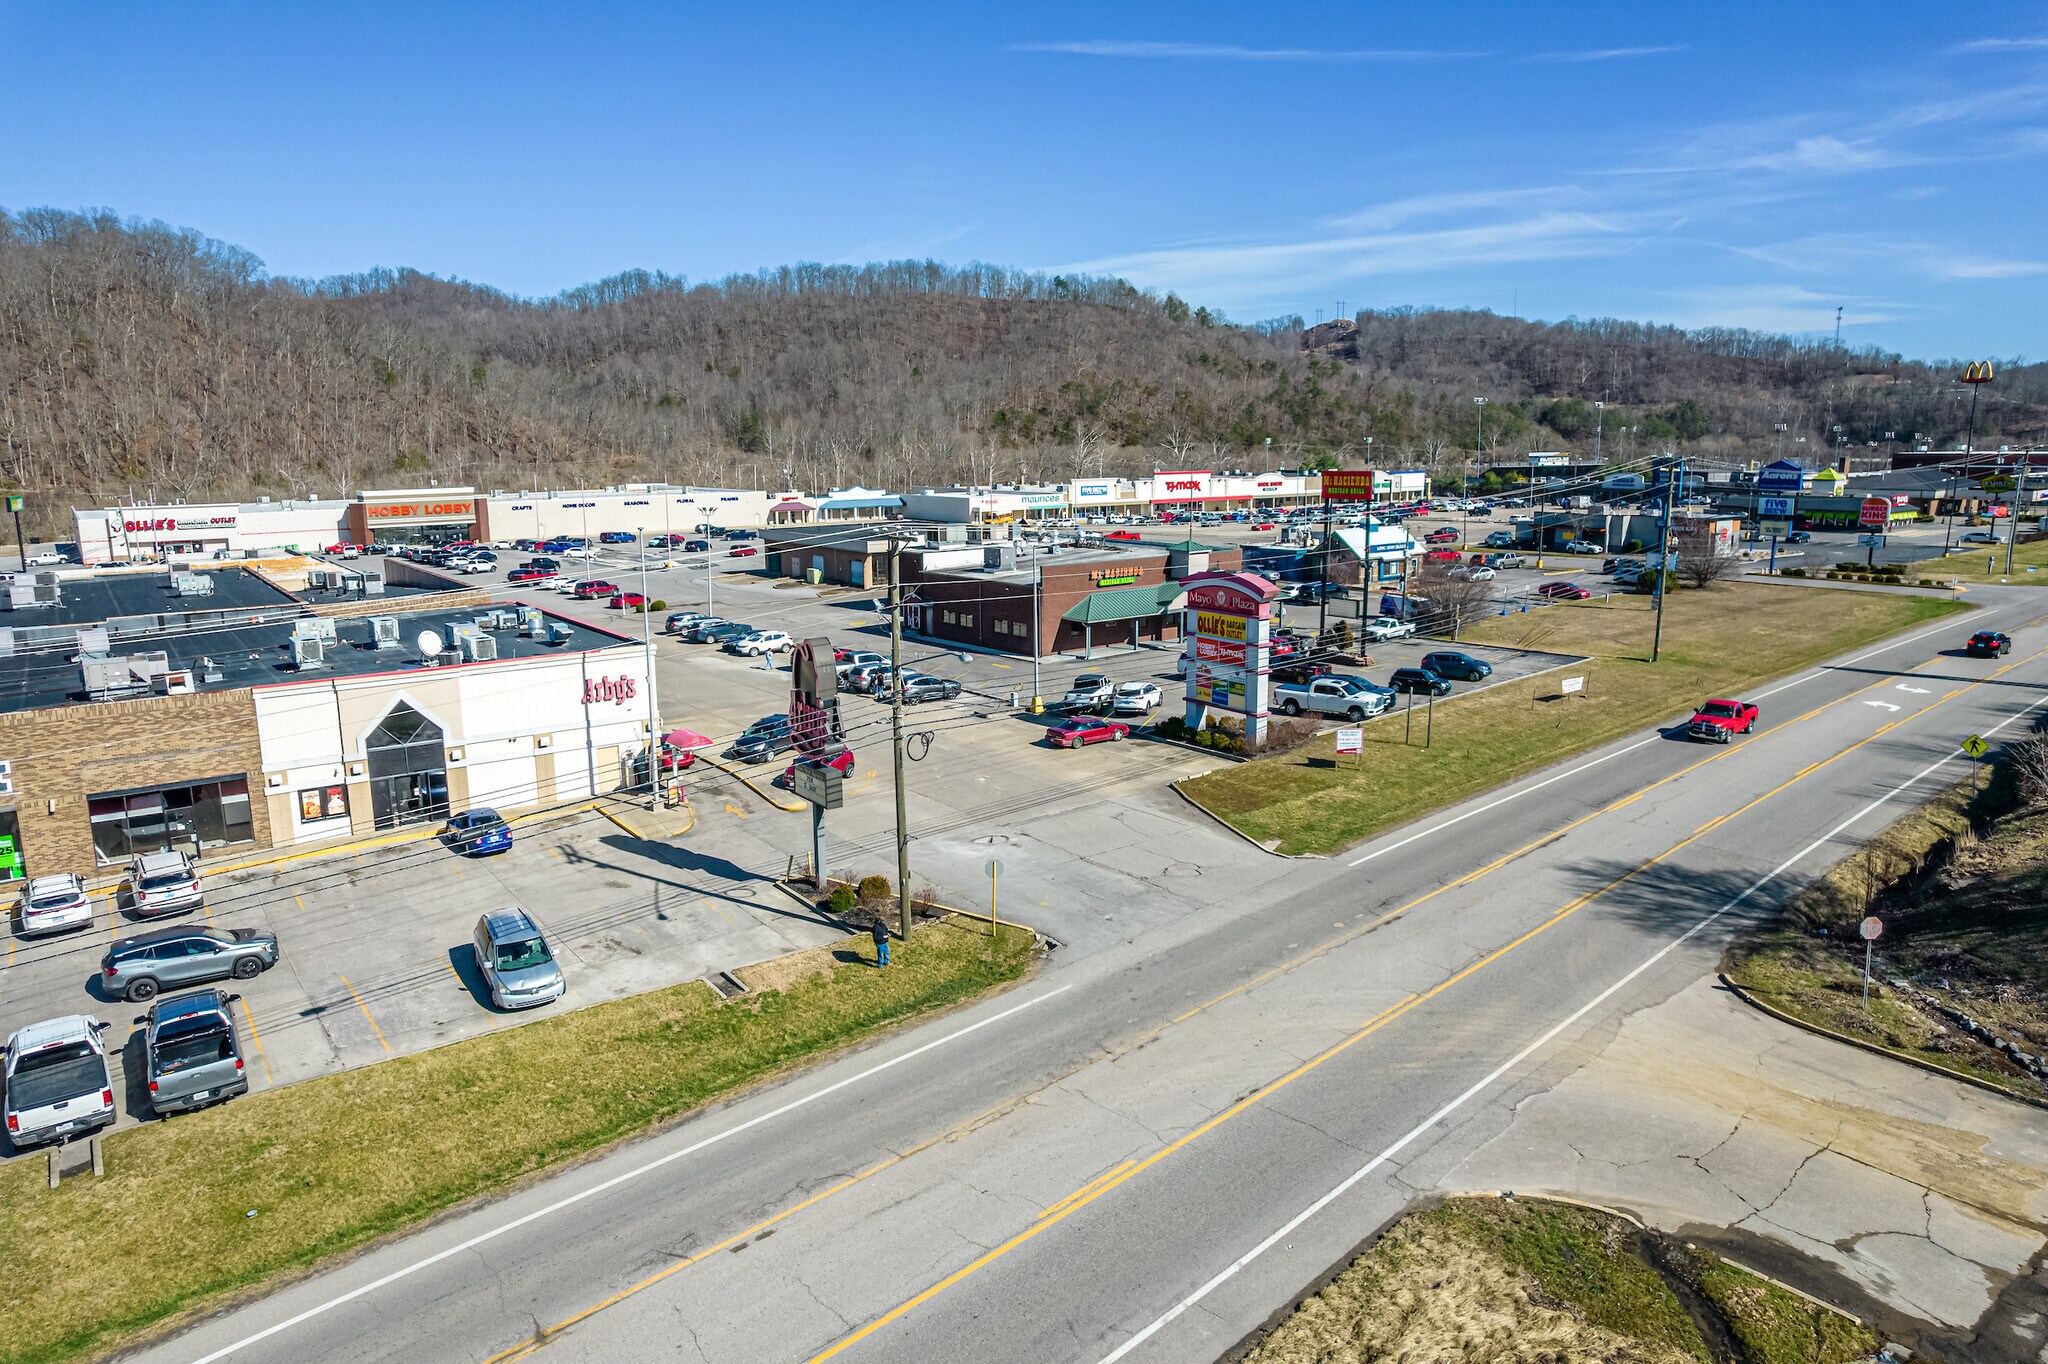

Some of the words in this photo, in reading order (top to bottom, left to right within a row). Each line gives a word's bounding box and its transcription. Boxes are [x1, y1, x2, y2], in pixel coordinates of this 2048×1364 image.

[1333, 475, 1370, 486] HACIENDA
[1761, 470, 1798, 480] Aaron's
[1021, 494, 1060, 504] maurices
[1765, 499, 1788, 507] five
[368, 503, 419, 518] HOBBY
[424, 501, 472, 516] LOBBY
[1861, 504, 1888, 512] BURGER
[1860, 510, 1888, 520] KING
[125, 517, 176, 532] OLLIE'S
[1189, 591, 1212, 607] Mayo
[1232, 597, 1255, 610] Plaza
[1197, 615, 1226, 637] OLLIE'S
[1226, 619, 1246, 631] BARGAIN
[1226, 629, 1243, 640] OUTLET
[1197, 641, 1216, 652] HOBBY
[1199, 647, 1218, 657] LOBBY
[581, 674, 637, 706] Arby's
[1861, 923, 1882, 933] STOP
